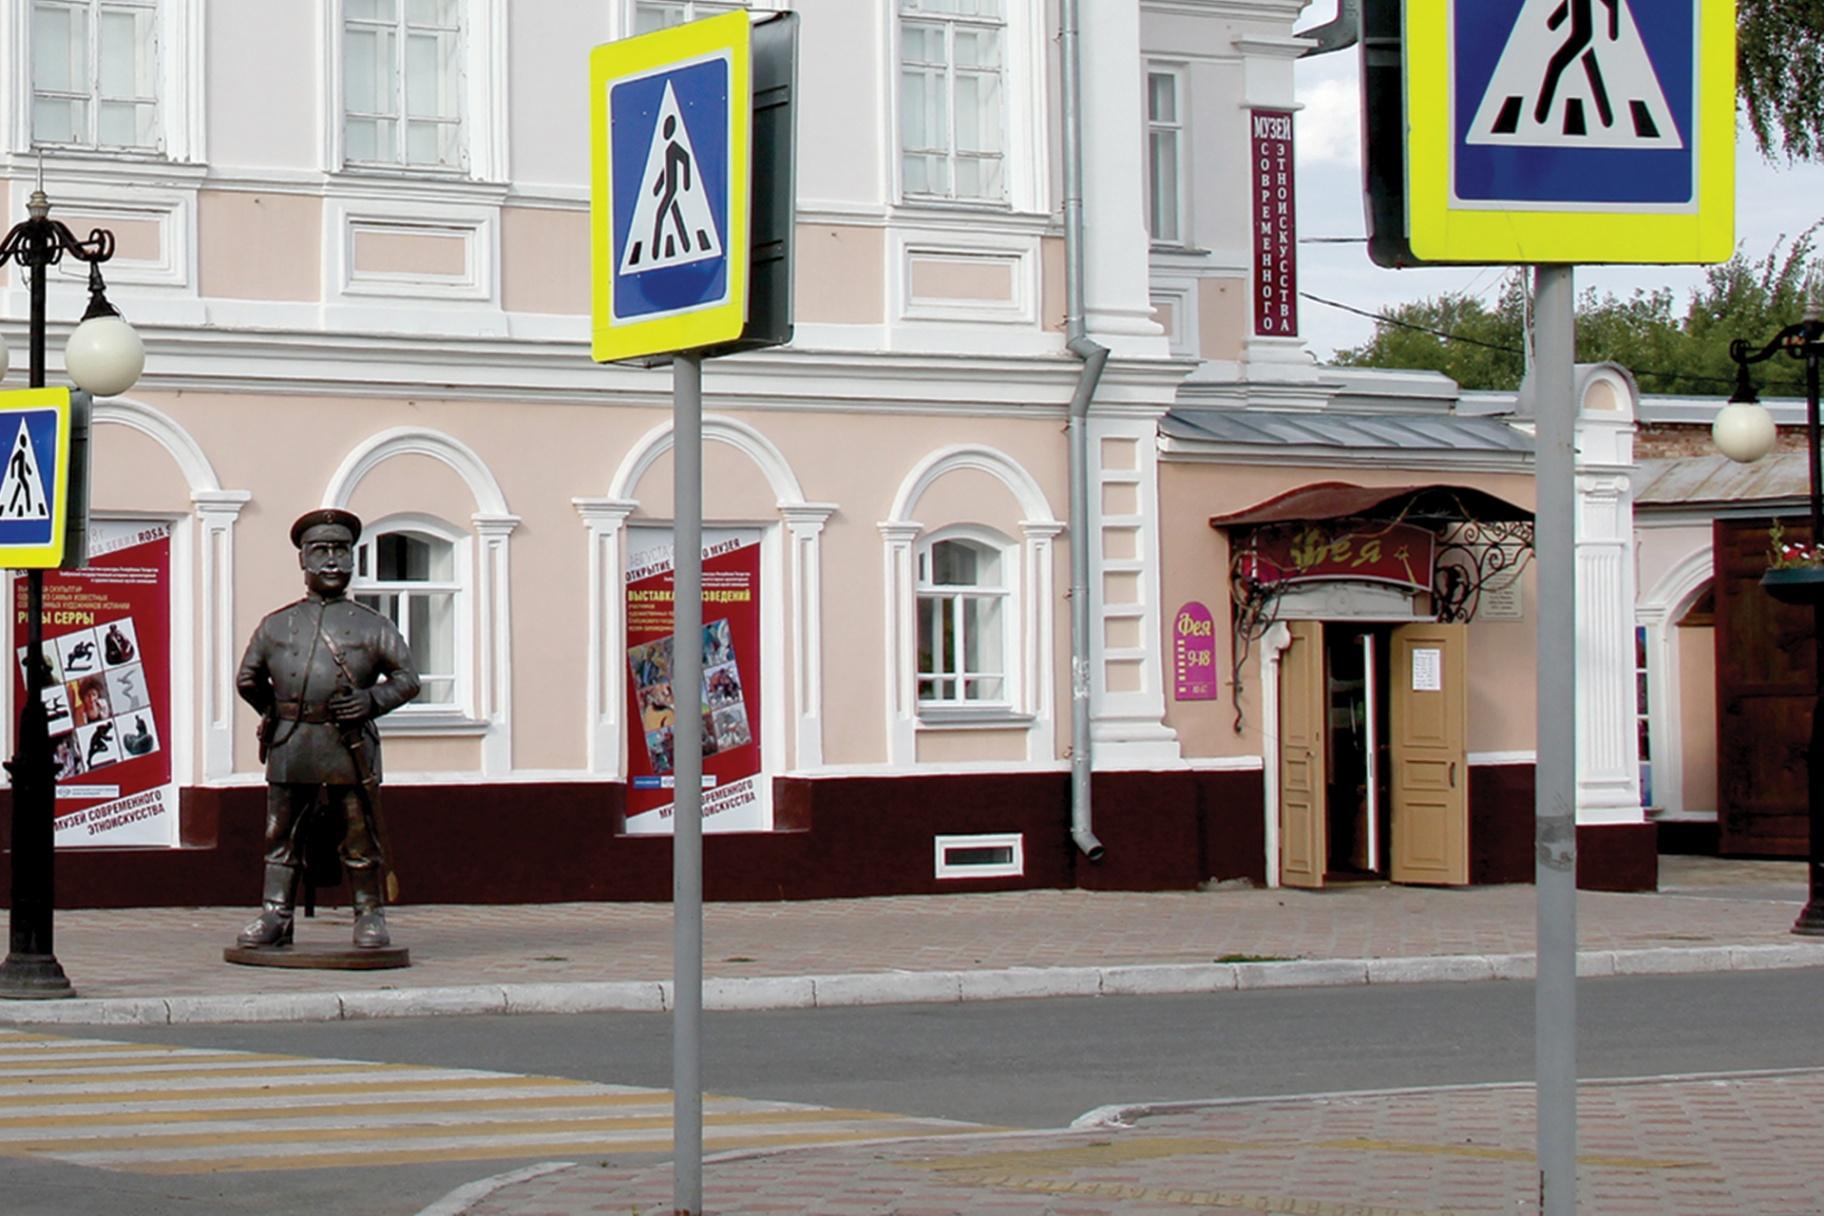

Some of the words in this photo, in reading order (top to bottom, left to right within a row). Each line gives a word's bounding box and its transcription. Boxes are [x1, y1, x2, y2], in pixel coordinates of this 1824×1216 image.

[1253, 115, 1291, 141] МУЗЕЙ
[1260, 142, 1273, 330] СОВРЕМЕННОГО
[1276, 142, 1290, 332] ЭТНОИСКУССТВА
[138, 525, 163, 543] ROSA
[626, 560, 671, 581] ОТКРЫТИЕ
[54, 611, 95, 625] СЕРРЫ
[1178, 612, 1211, 637] Фея
[87, 789, 162, 822] СОВРЕМЕННОГО
